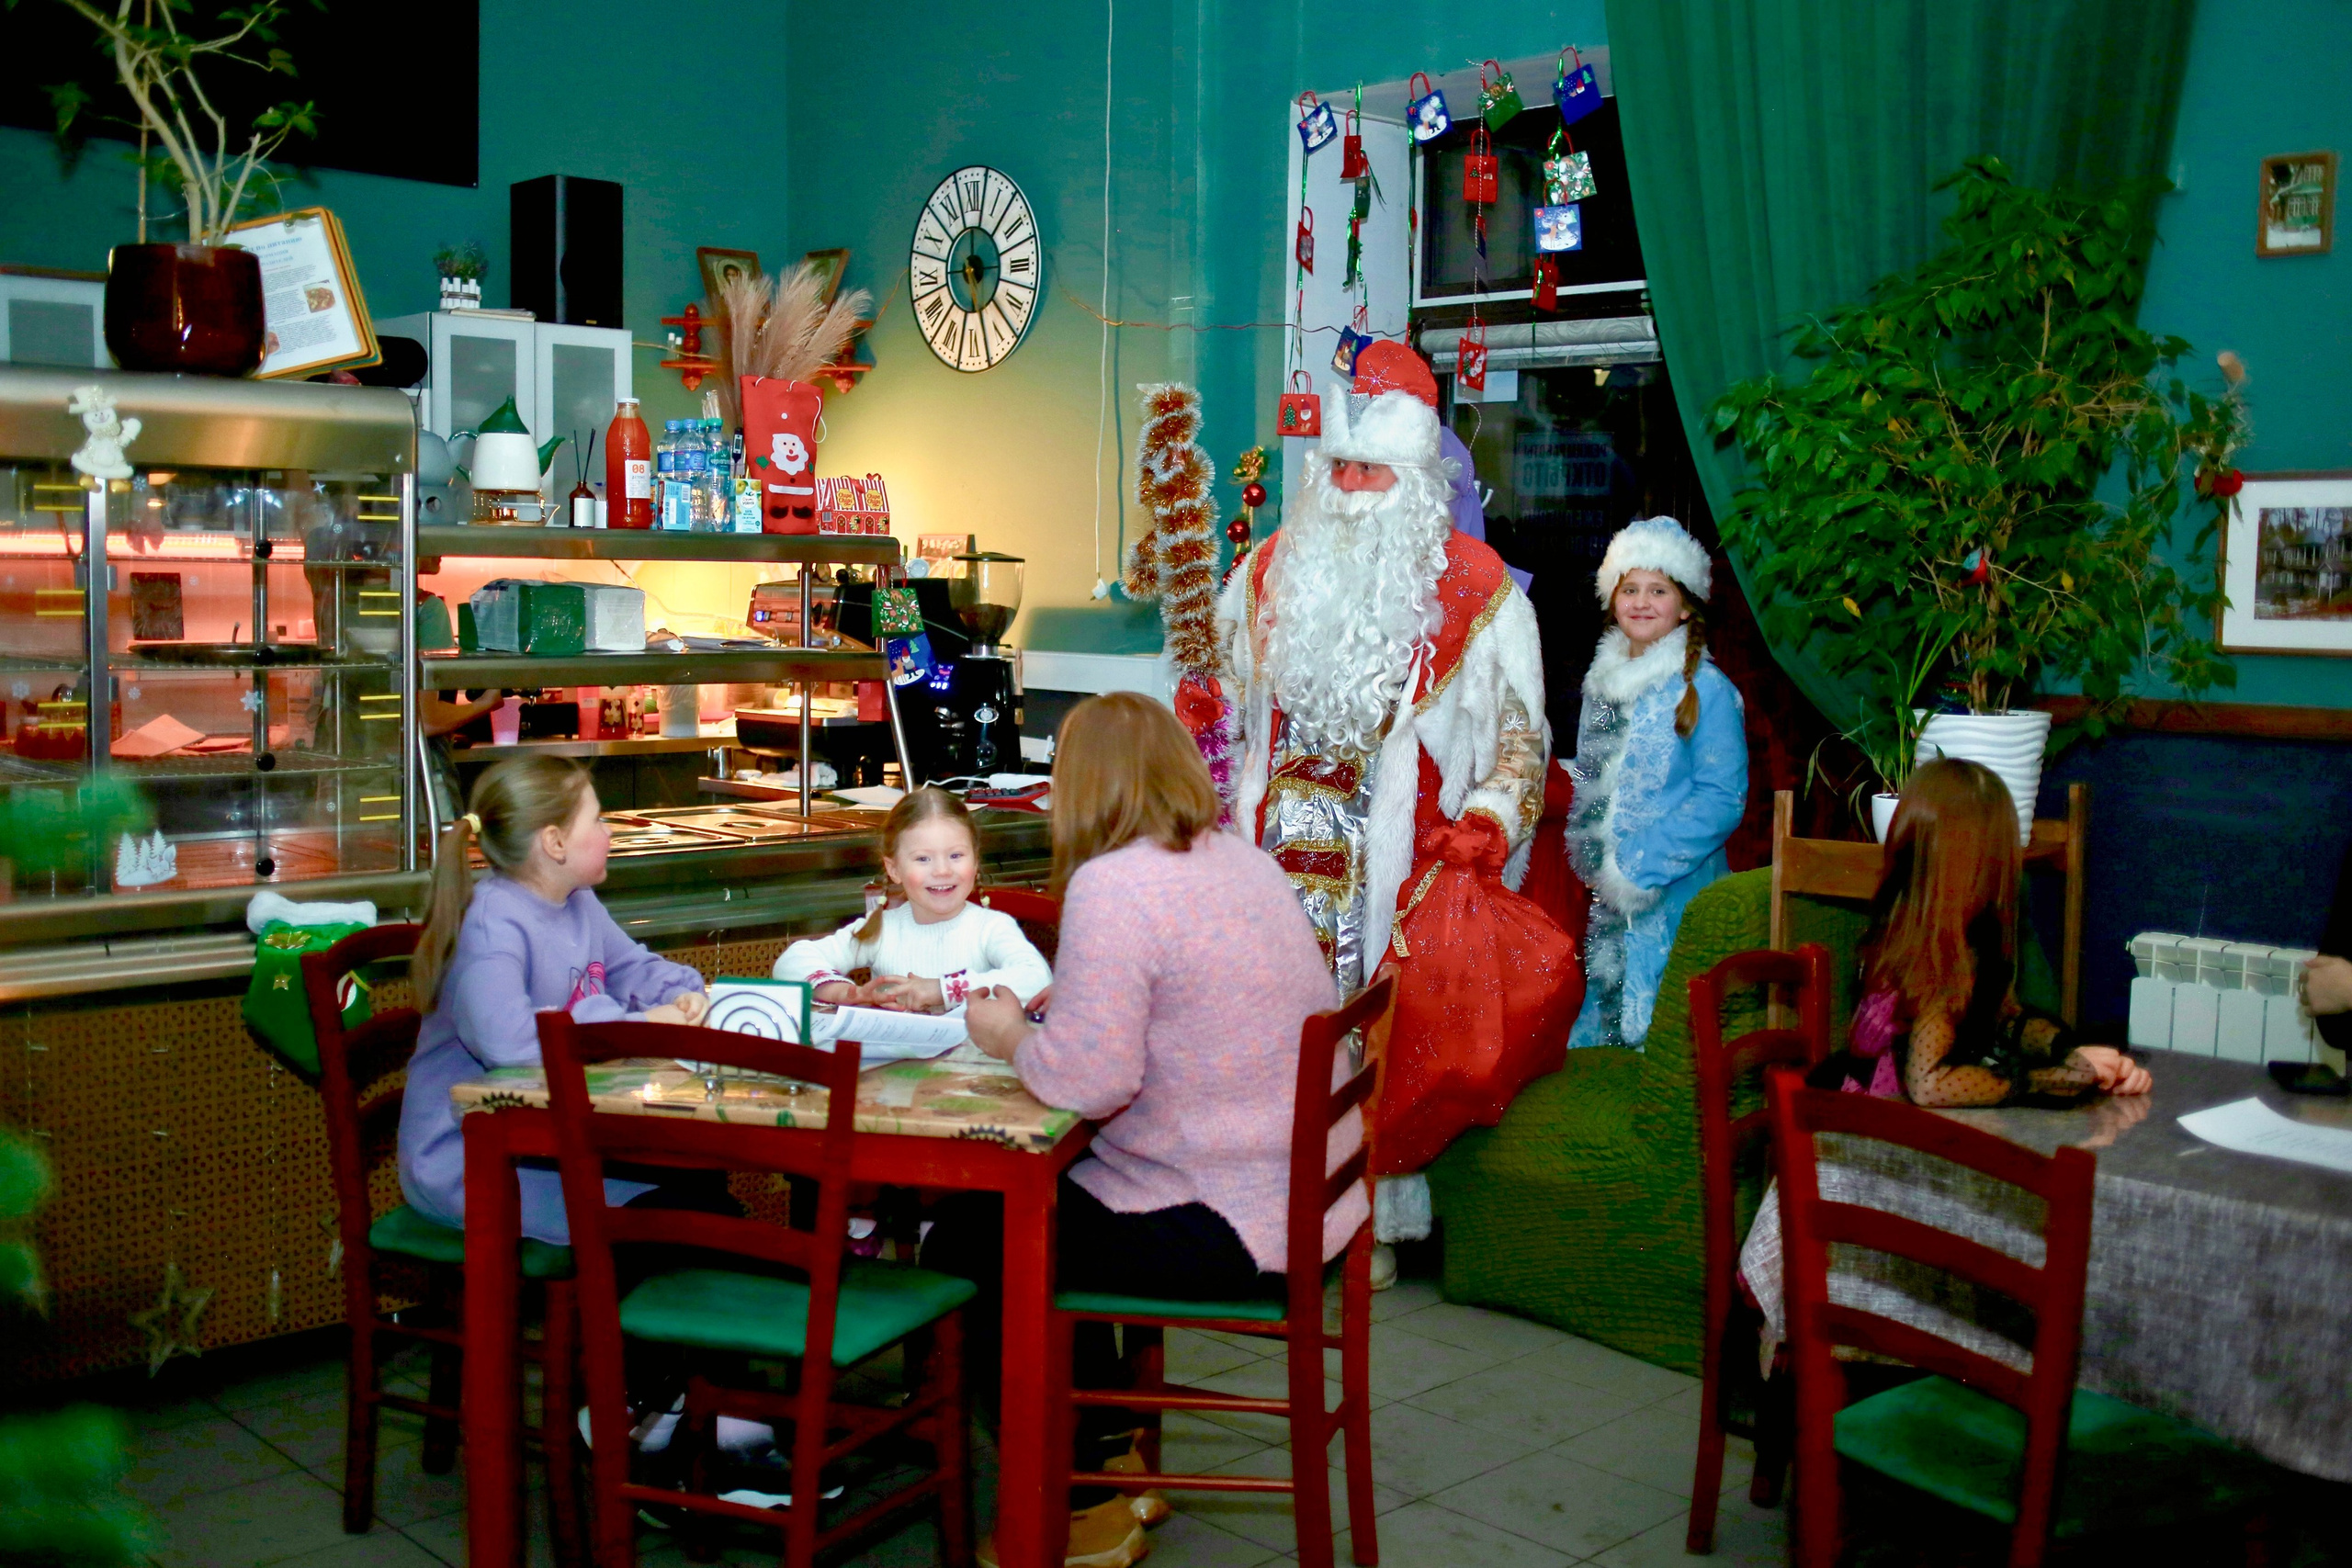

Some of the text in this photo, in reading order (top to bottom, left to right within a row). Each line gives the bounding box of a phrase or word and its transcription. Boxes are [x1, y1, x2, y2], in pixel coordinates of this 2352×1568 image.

[938, 192, 960, 228] XI
[964, 180, 982, 214] XII
[989, 187, 1002, 219] I
[923, 228, 944, 253] X
[1002, 213, 1024, 243] II
[920, 266, 937, 287] IX
[1010, 255, 1030, 276] III
[1005, 288, 1024, 319] IV
[942, 319, 958, 353] VII
[968, 329, 980, 357] VI
[991, 321, 1005, 347] V
[632, 464, 645, 474] 08
